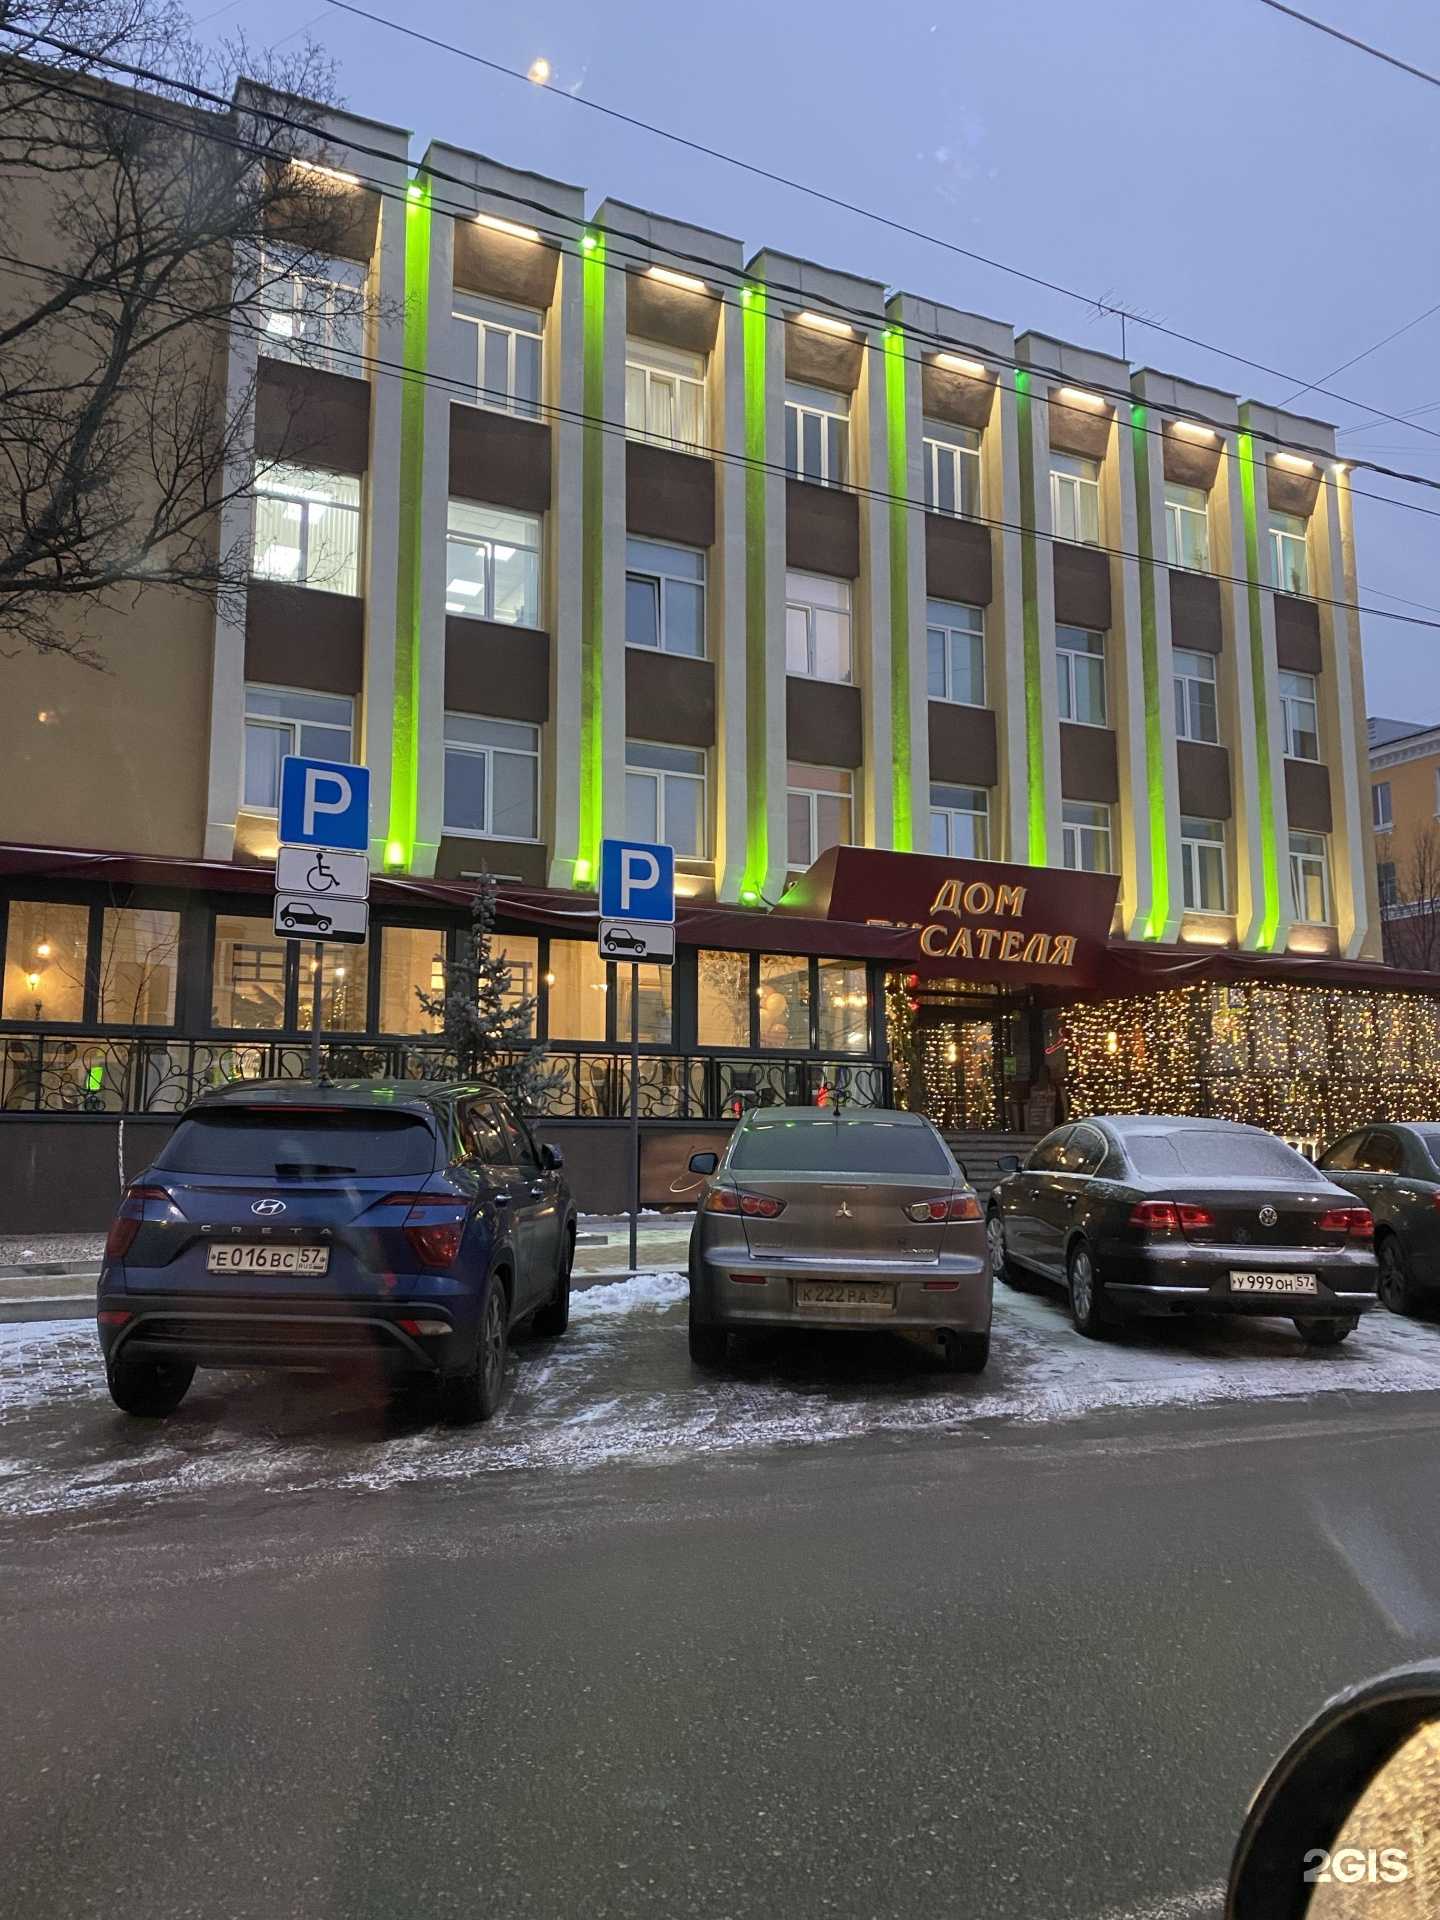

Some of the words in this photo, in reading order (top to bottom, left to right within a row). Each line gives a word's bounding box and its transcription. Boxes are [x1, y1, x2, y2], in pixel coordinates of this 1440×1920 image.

[302, 768, 353, 836] P
[620, 848, 660, 911] P
[929, 878, 1028, 919] ДОМ
[866, 918, 1078, 967] САТЕЛЯ
[198, 1223, 332, 1235] CRETA
